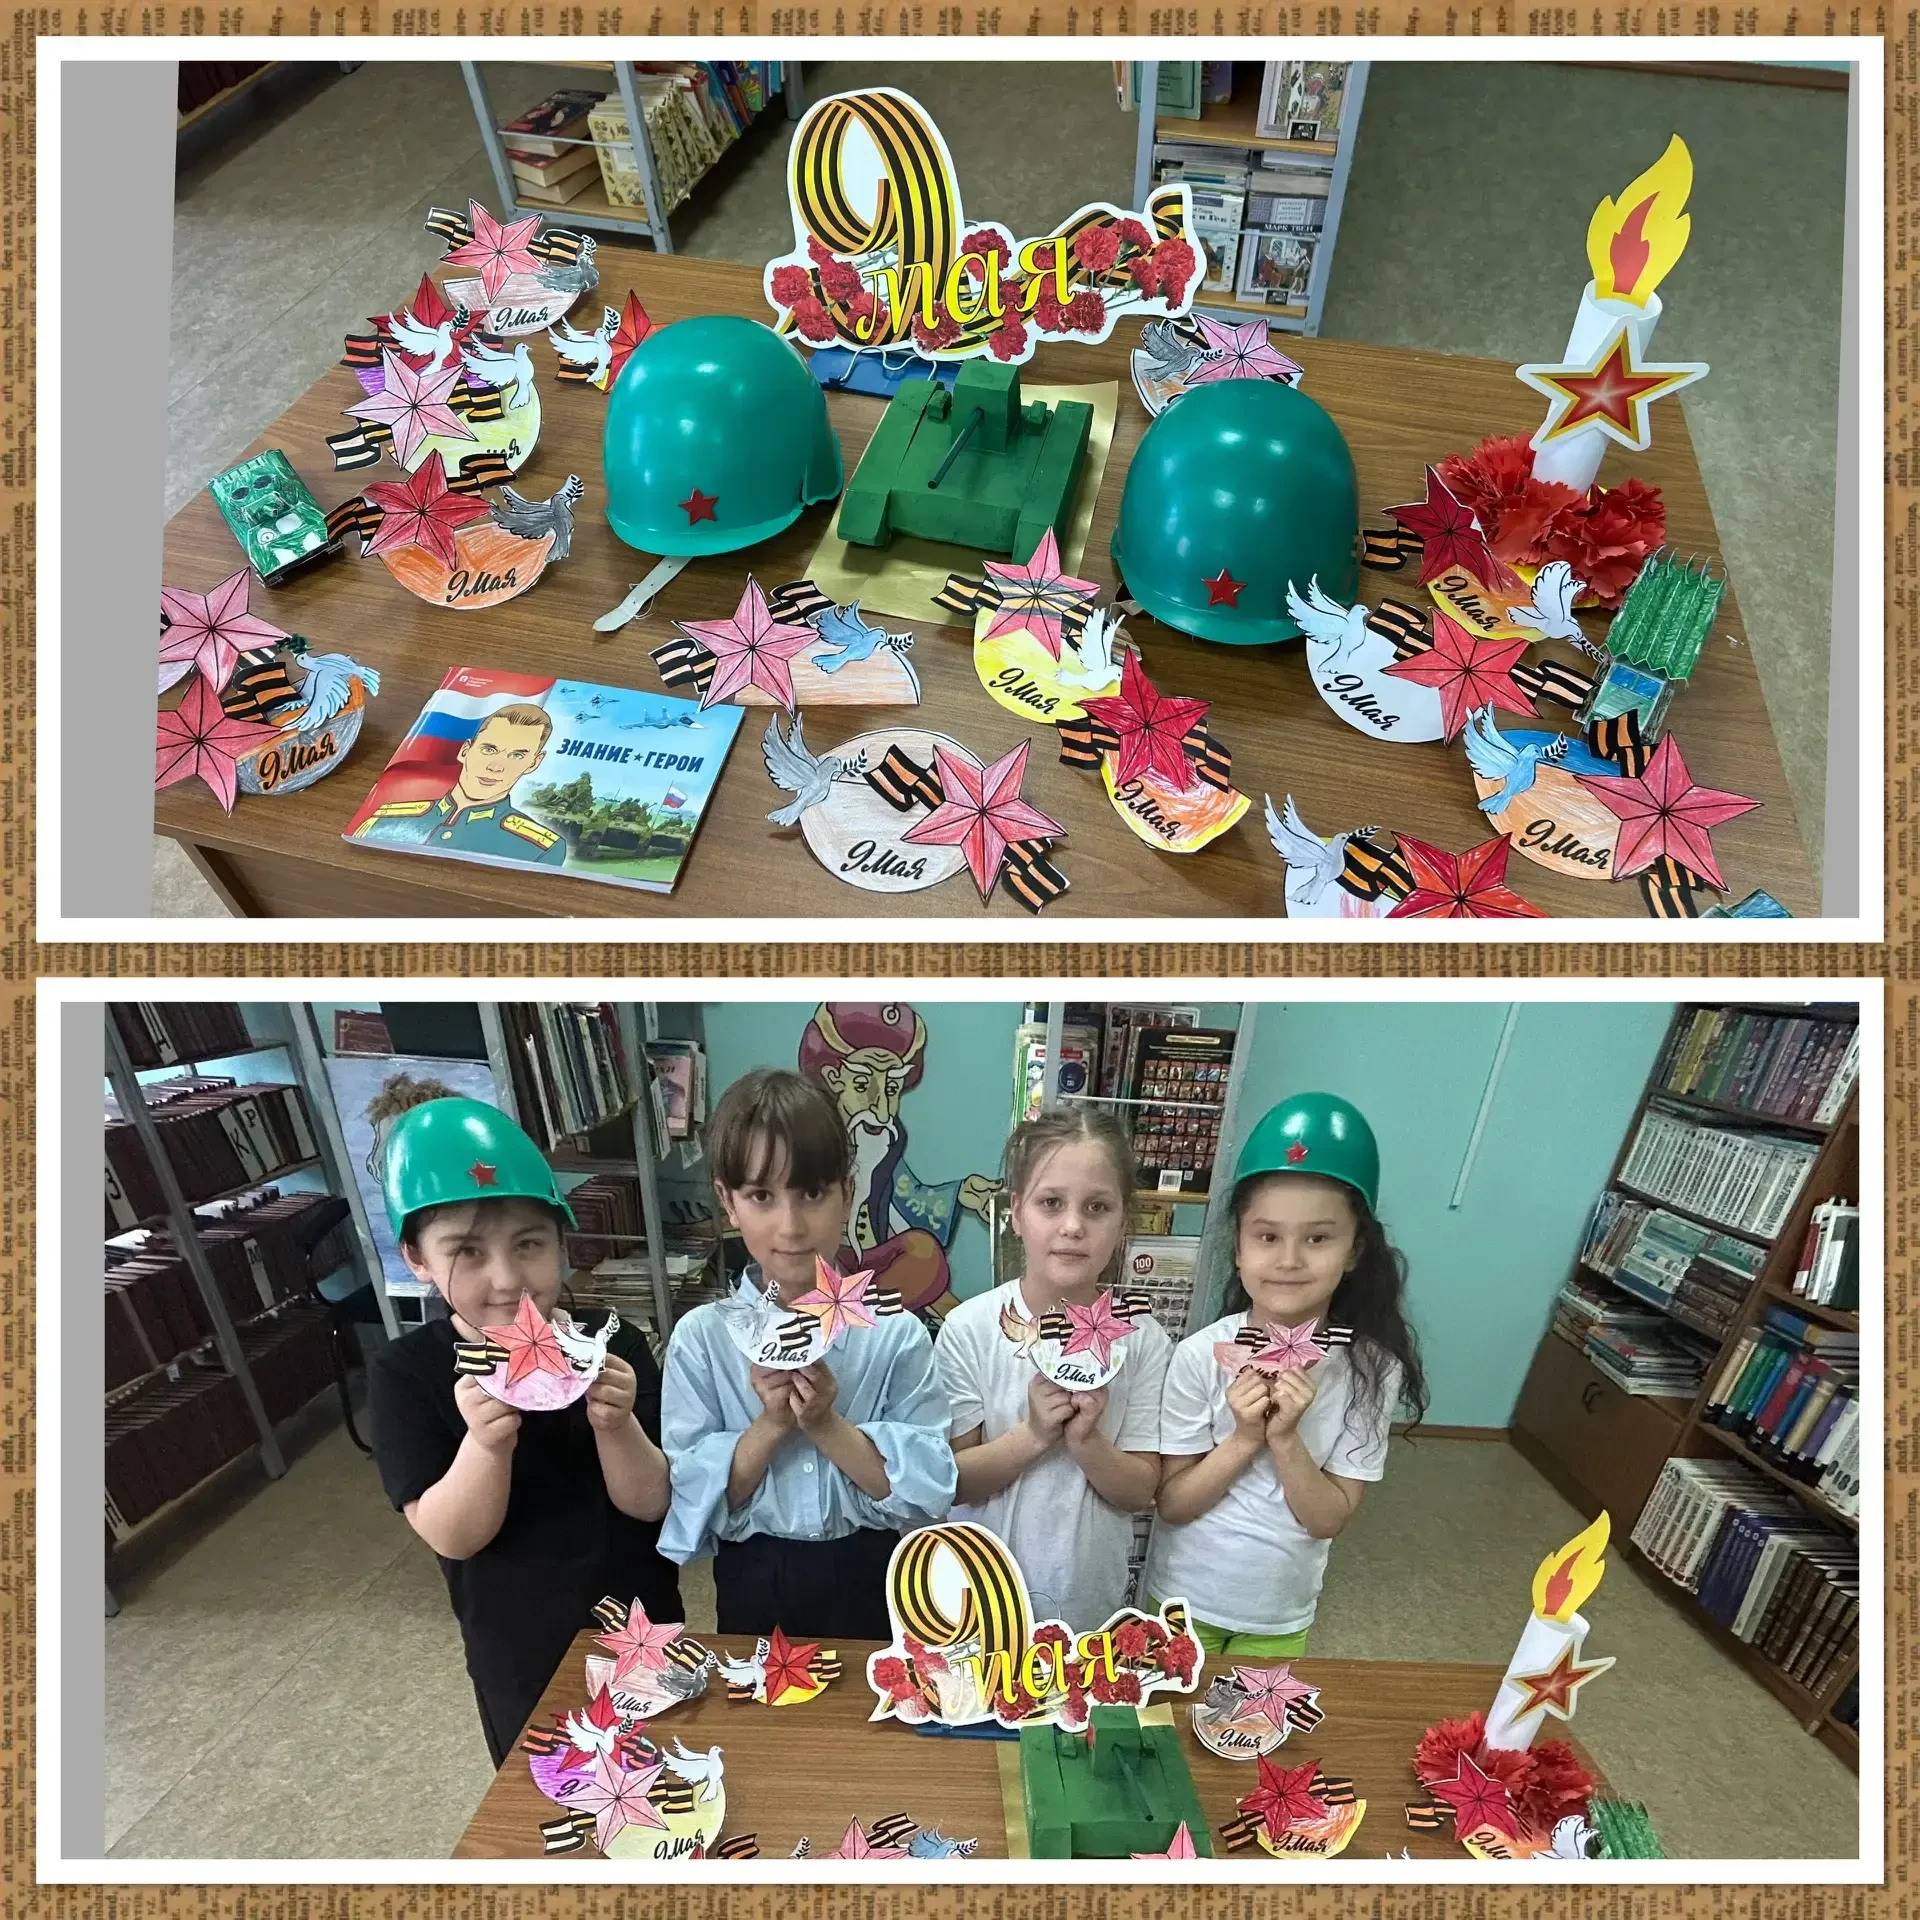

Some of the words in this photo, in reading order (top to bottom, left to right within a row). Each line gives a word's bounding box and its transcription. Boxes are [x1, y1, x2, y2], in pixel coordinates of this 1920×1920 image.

[792, 92, 957, 346] 9
[1264, 223, 1289, 232] МАРК
[1290, 224, 1314, 233] ТВЕН
[556, 738, 634, 764] ЗНАНИЕ
[643, 751, 705, 773] ГЕРОИ
[1135, 1257, 1152, 1269] 100
[893, 1525, 1030, 1719] 9
